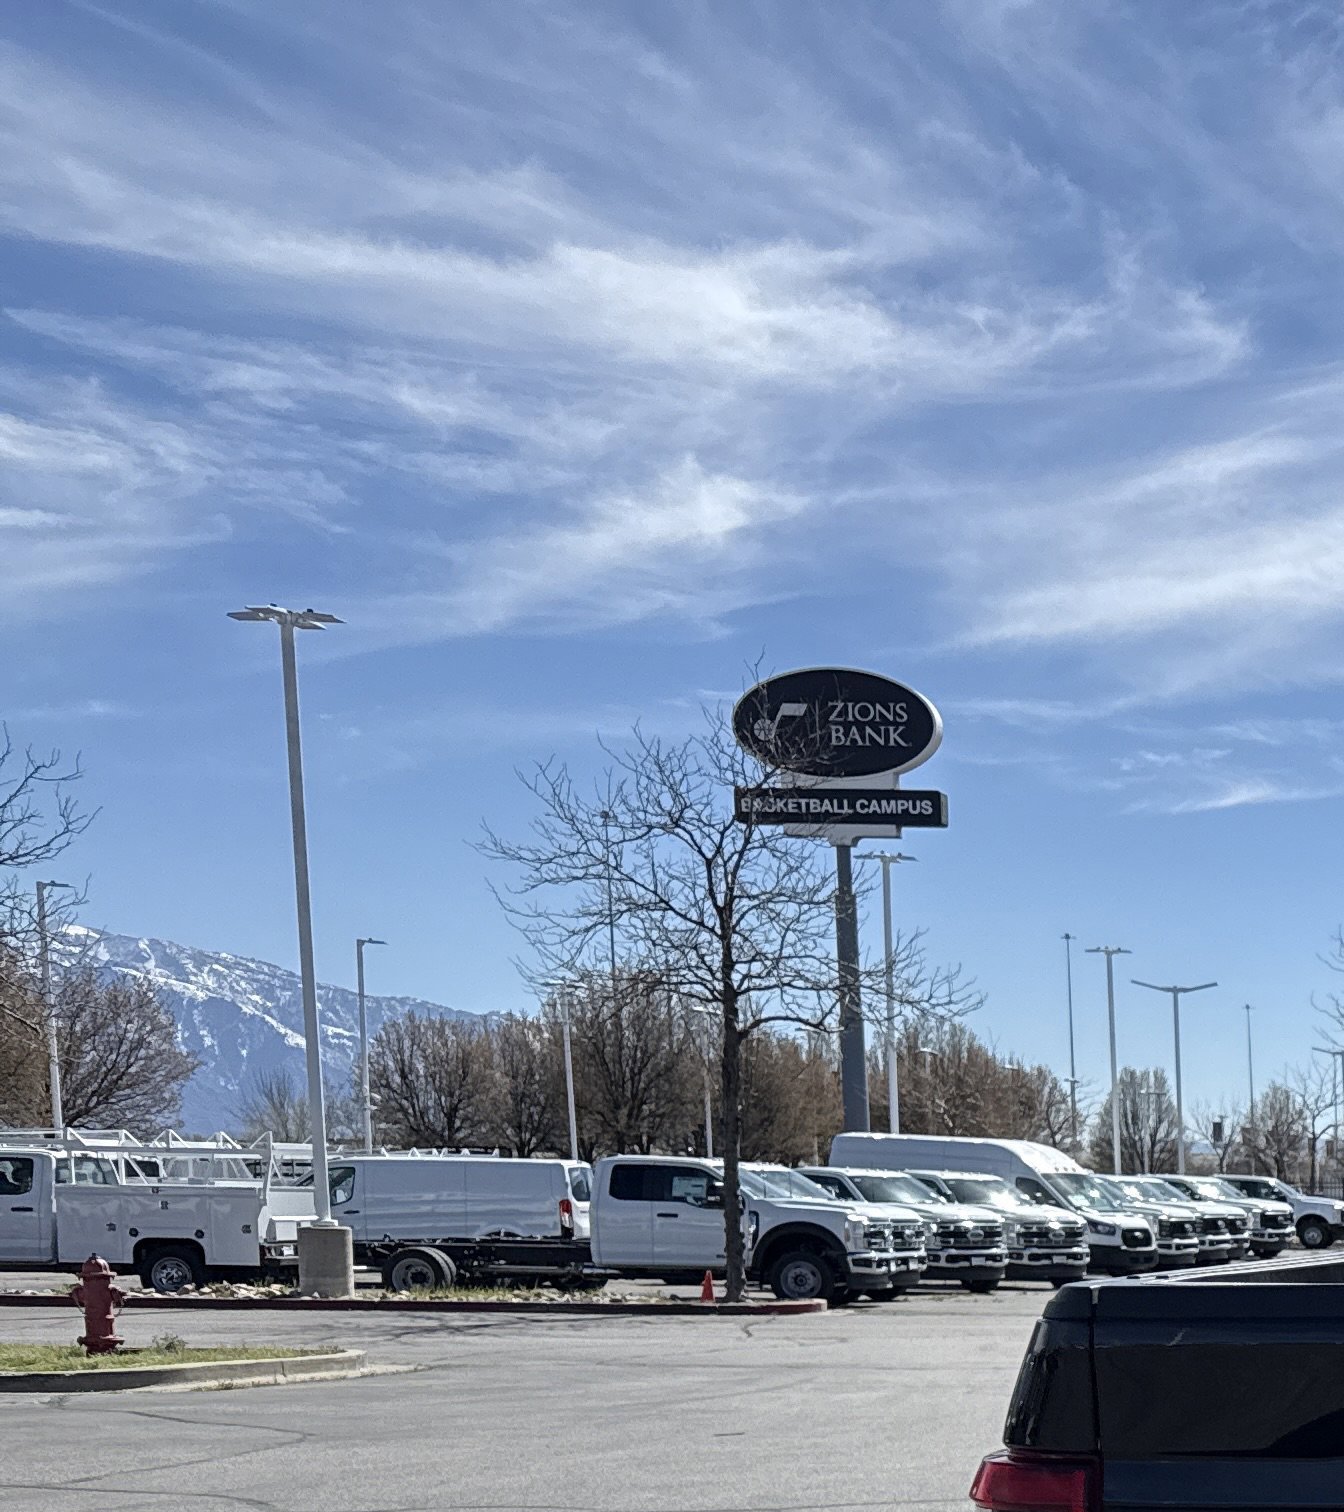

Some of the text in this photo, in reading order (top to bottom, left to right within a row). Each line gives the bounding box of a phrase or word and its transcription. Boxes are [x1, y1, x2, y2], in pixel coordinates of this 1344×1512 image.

[828, 702, 908, 723] ZIONS
[829, 726, 909, 747] BANK
[855, 798, 933, 815] CAMPUS
